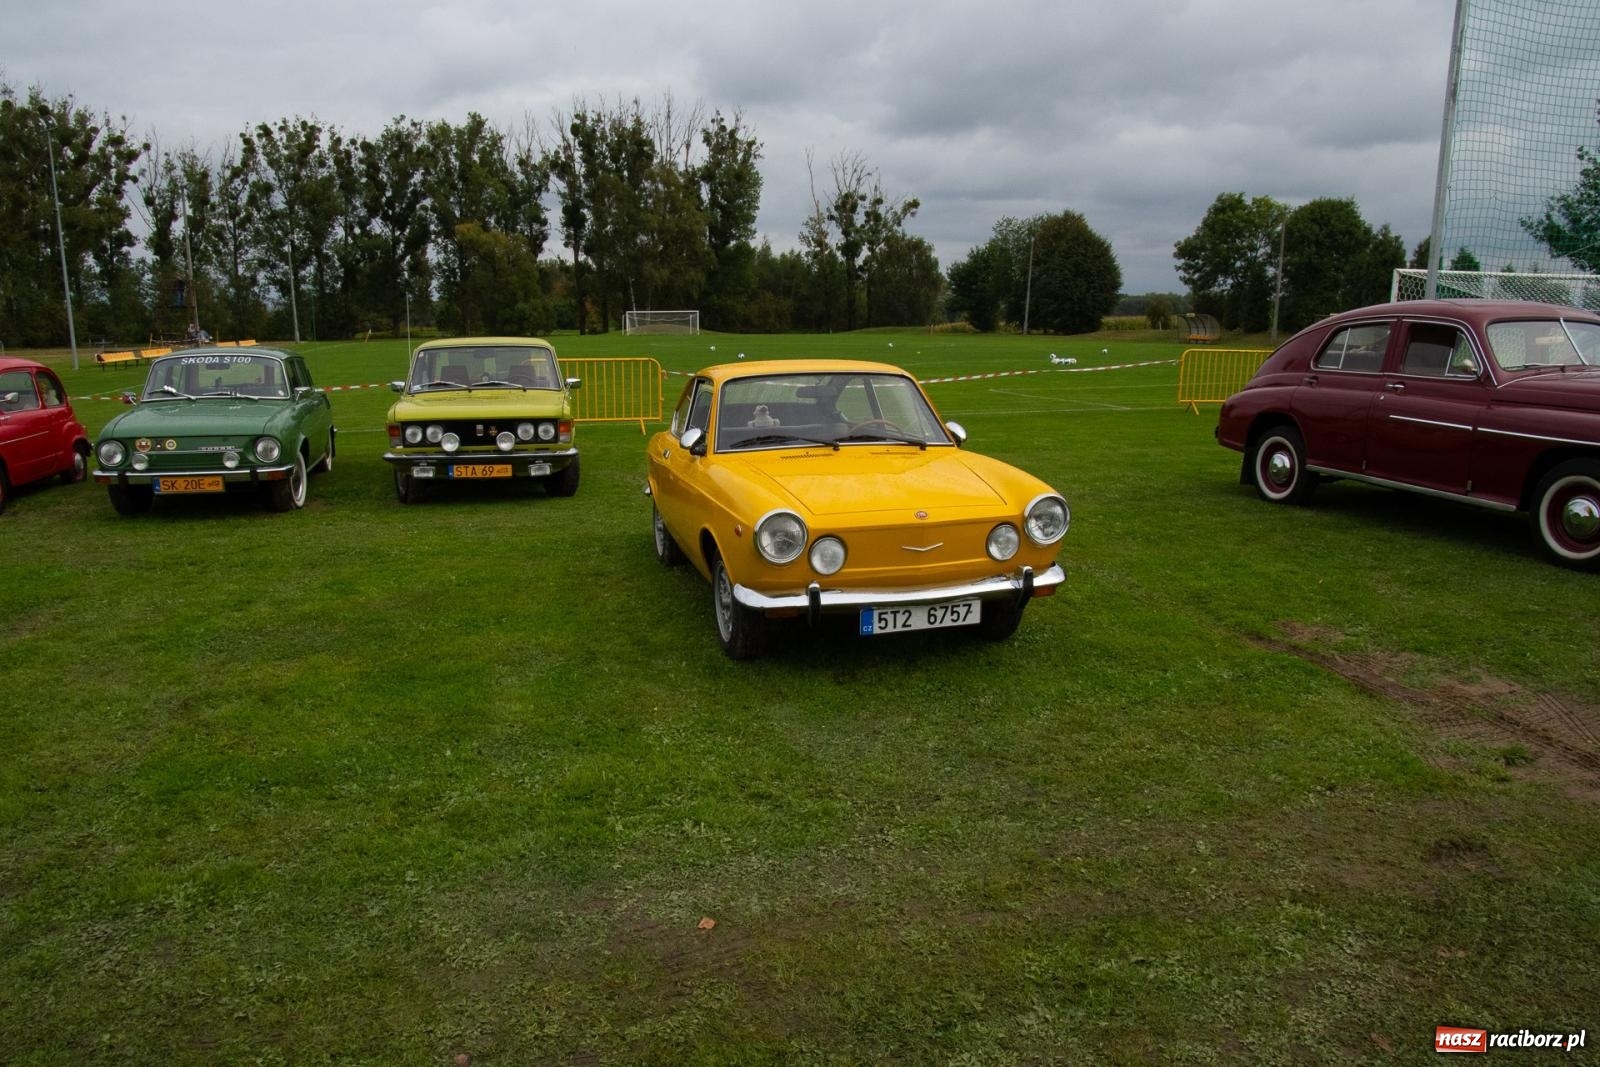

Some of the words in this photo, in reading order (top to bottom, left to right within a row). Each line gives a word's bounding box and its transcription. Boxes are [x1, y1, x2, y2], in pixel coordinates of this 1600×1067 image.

[181, 356, 220, 365] SKODA
[223, 356, 252, 364] S100
[455, 465, 477, 477] STA
[481, 465, 495, 477] 69
[161, 479, 178, 491] SK
[183, 478, 206, 490] 20E
[877, 609, 913, 630] 5T2
[927, 603, 973, 625] 6757
